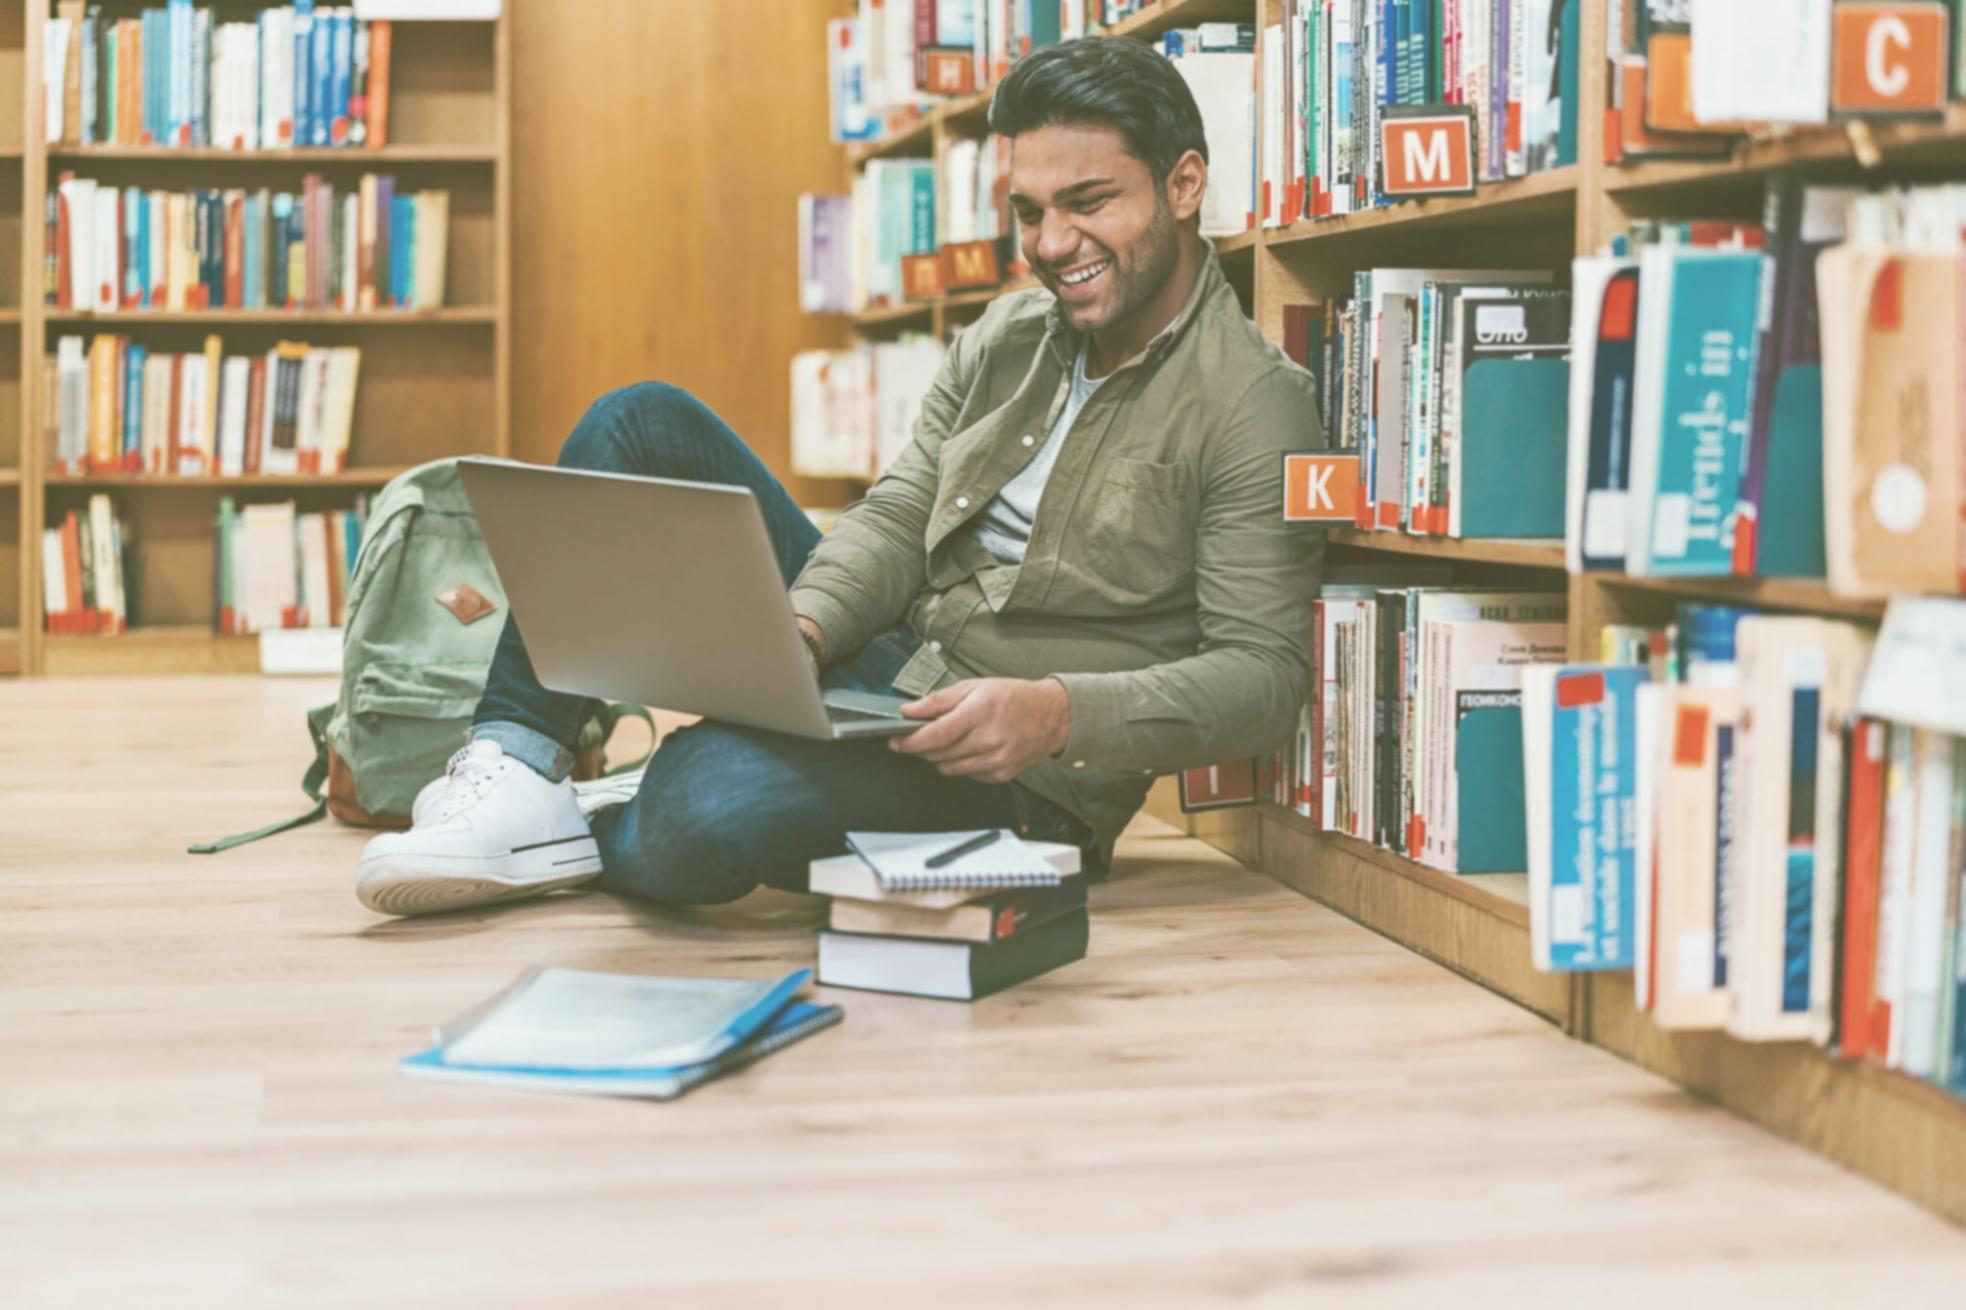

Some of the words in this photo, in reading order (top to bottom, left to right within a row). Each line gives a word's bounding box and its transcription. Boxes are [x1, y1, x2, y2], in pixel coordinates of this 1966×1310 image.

[1866, 15, 1911, 97] C
[1402, 129, 1452, 183] M
[954, 247, 986, 280] M
[1307, 464, 1336, 510] K
